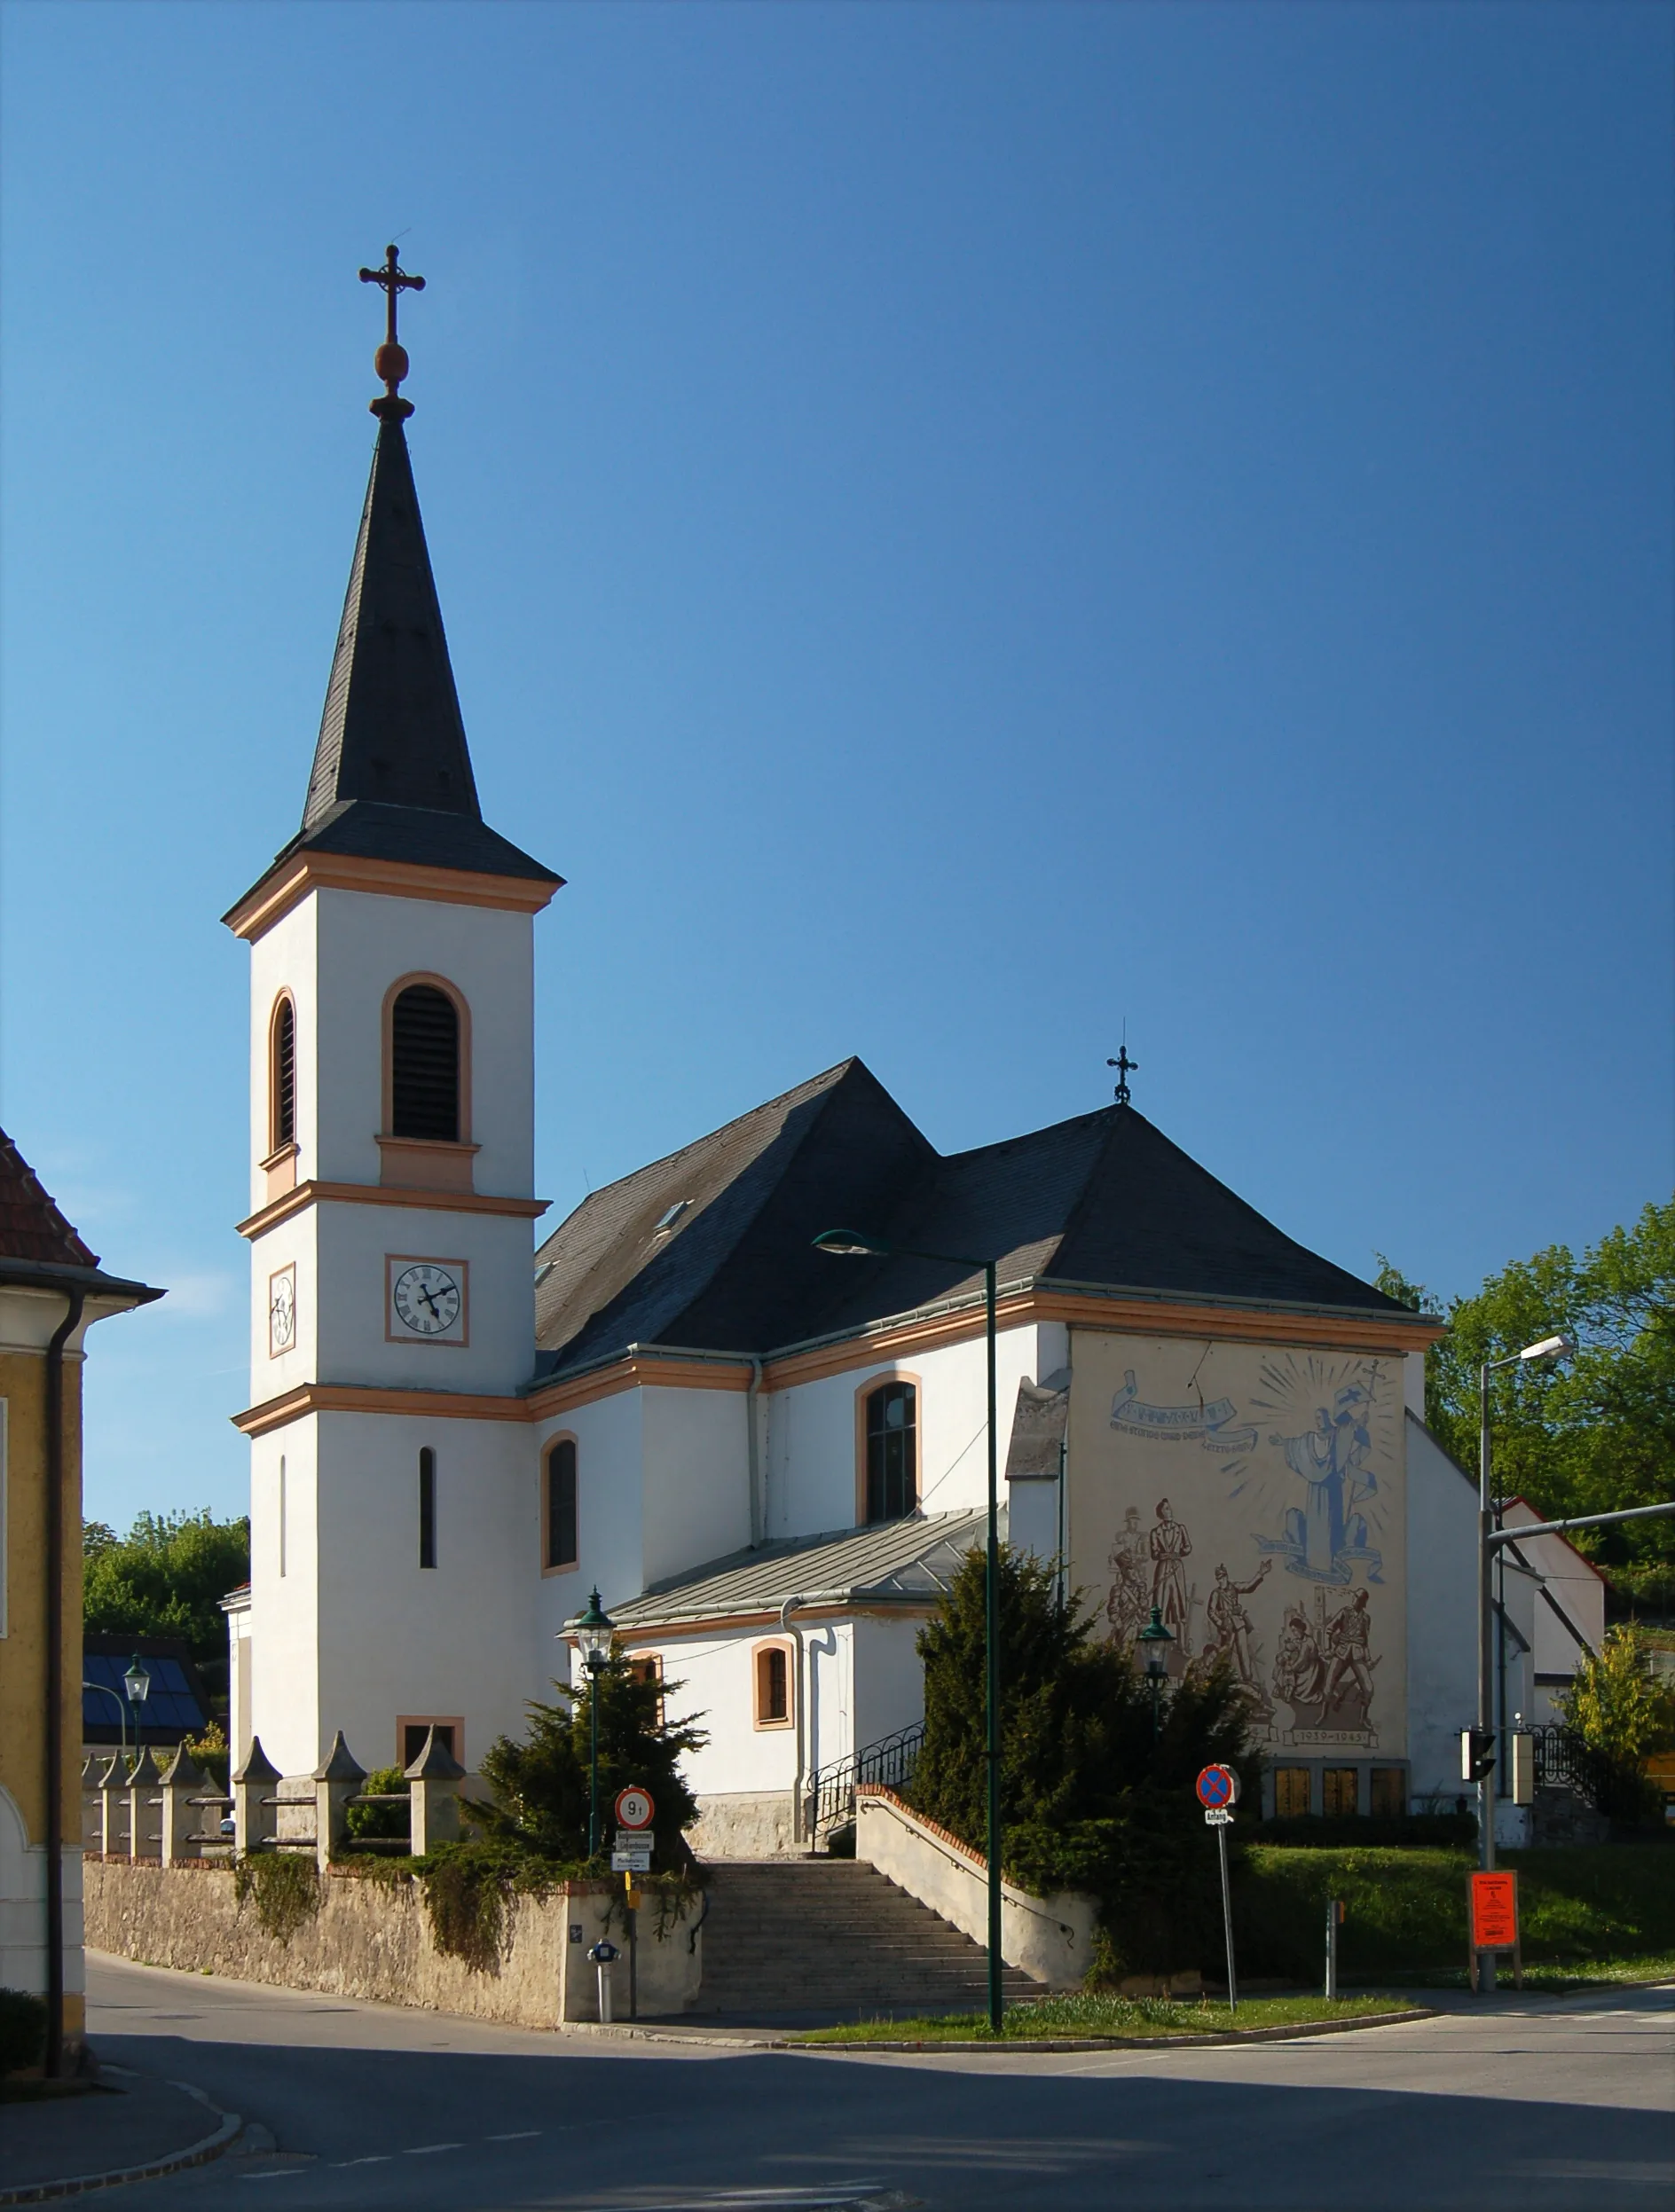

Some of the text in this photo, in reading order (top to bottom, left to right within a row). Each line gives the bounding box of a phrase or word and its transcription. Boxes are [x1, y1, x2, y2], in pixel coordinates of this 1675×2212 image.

[628, 1800, 642, 1816] 9 t
[1207, 1812, 1226, 1822] Anfang
